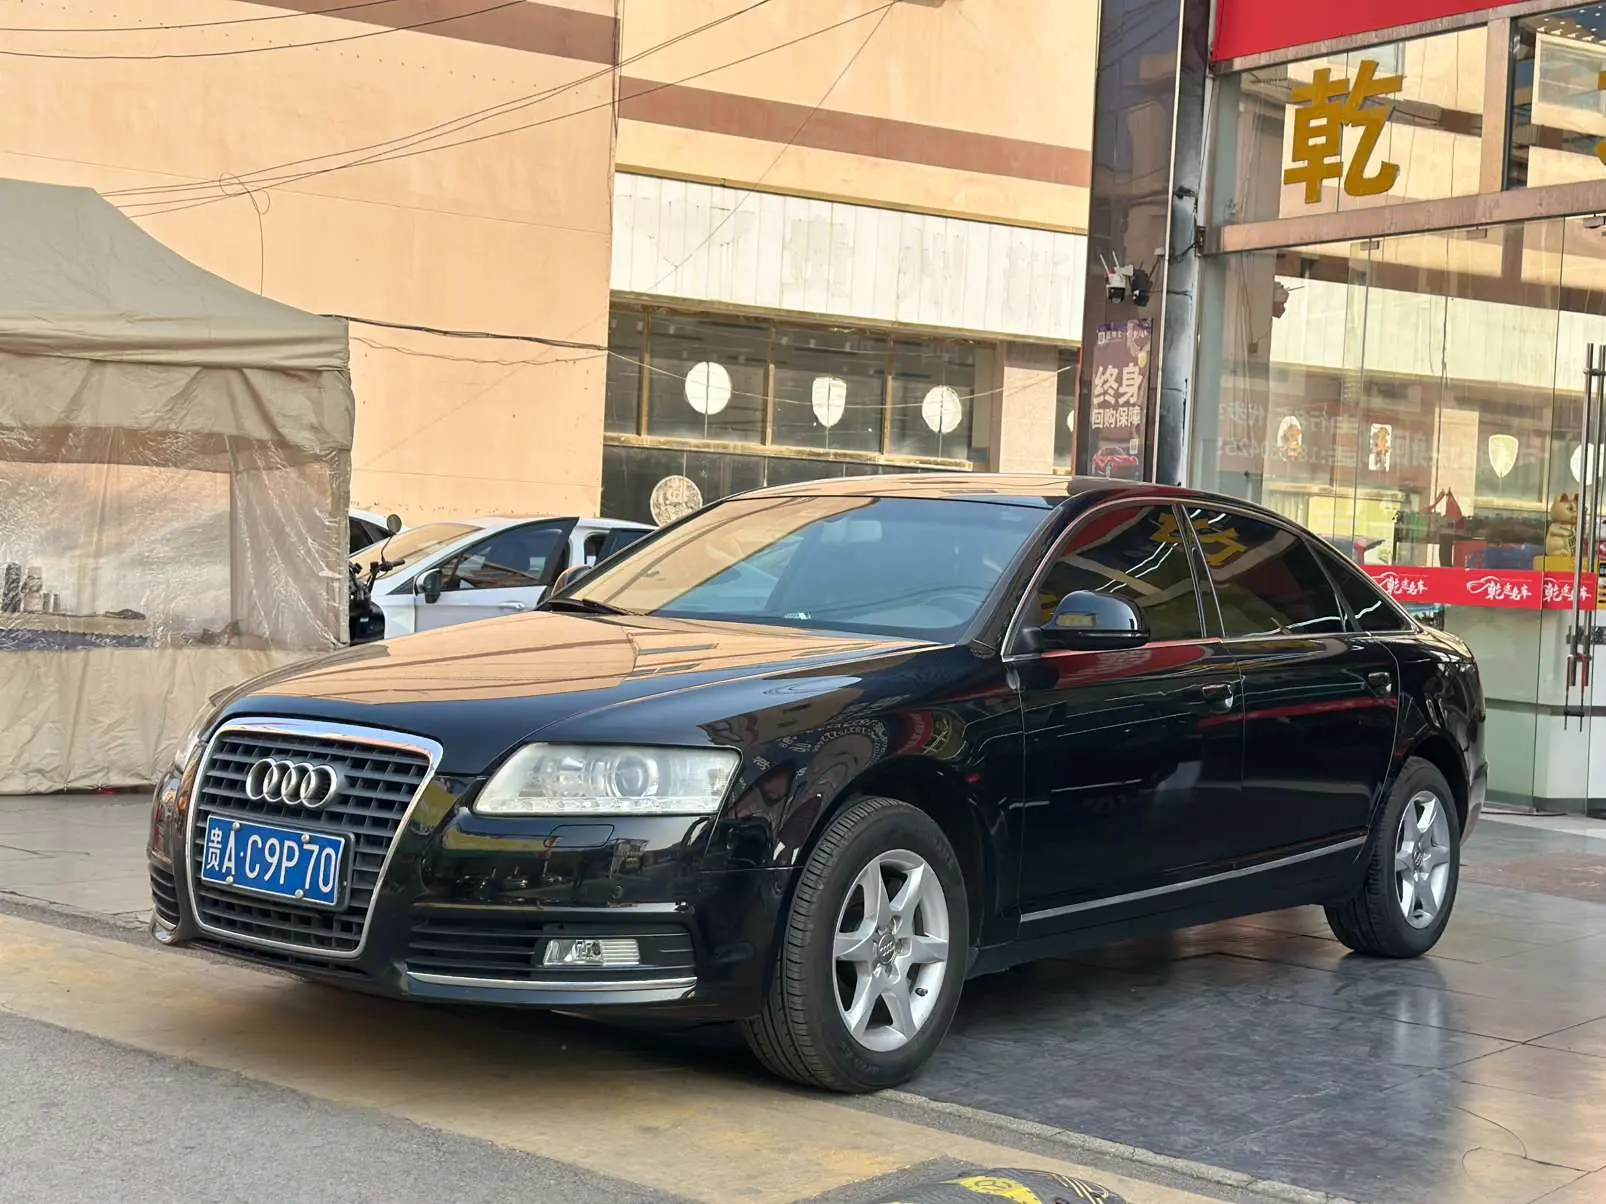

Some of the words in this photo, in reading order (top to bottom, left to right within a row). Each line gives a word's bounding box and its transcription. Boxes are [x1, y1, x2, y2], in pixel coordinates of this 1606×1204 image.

[1284, 60, 1406, 204] 乾
[1094, 363, 1143, 405] 终身
[1092, 406, 1141, 429] 回购保障
